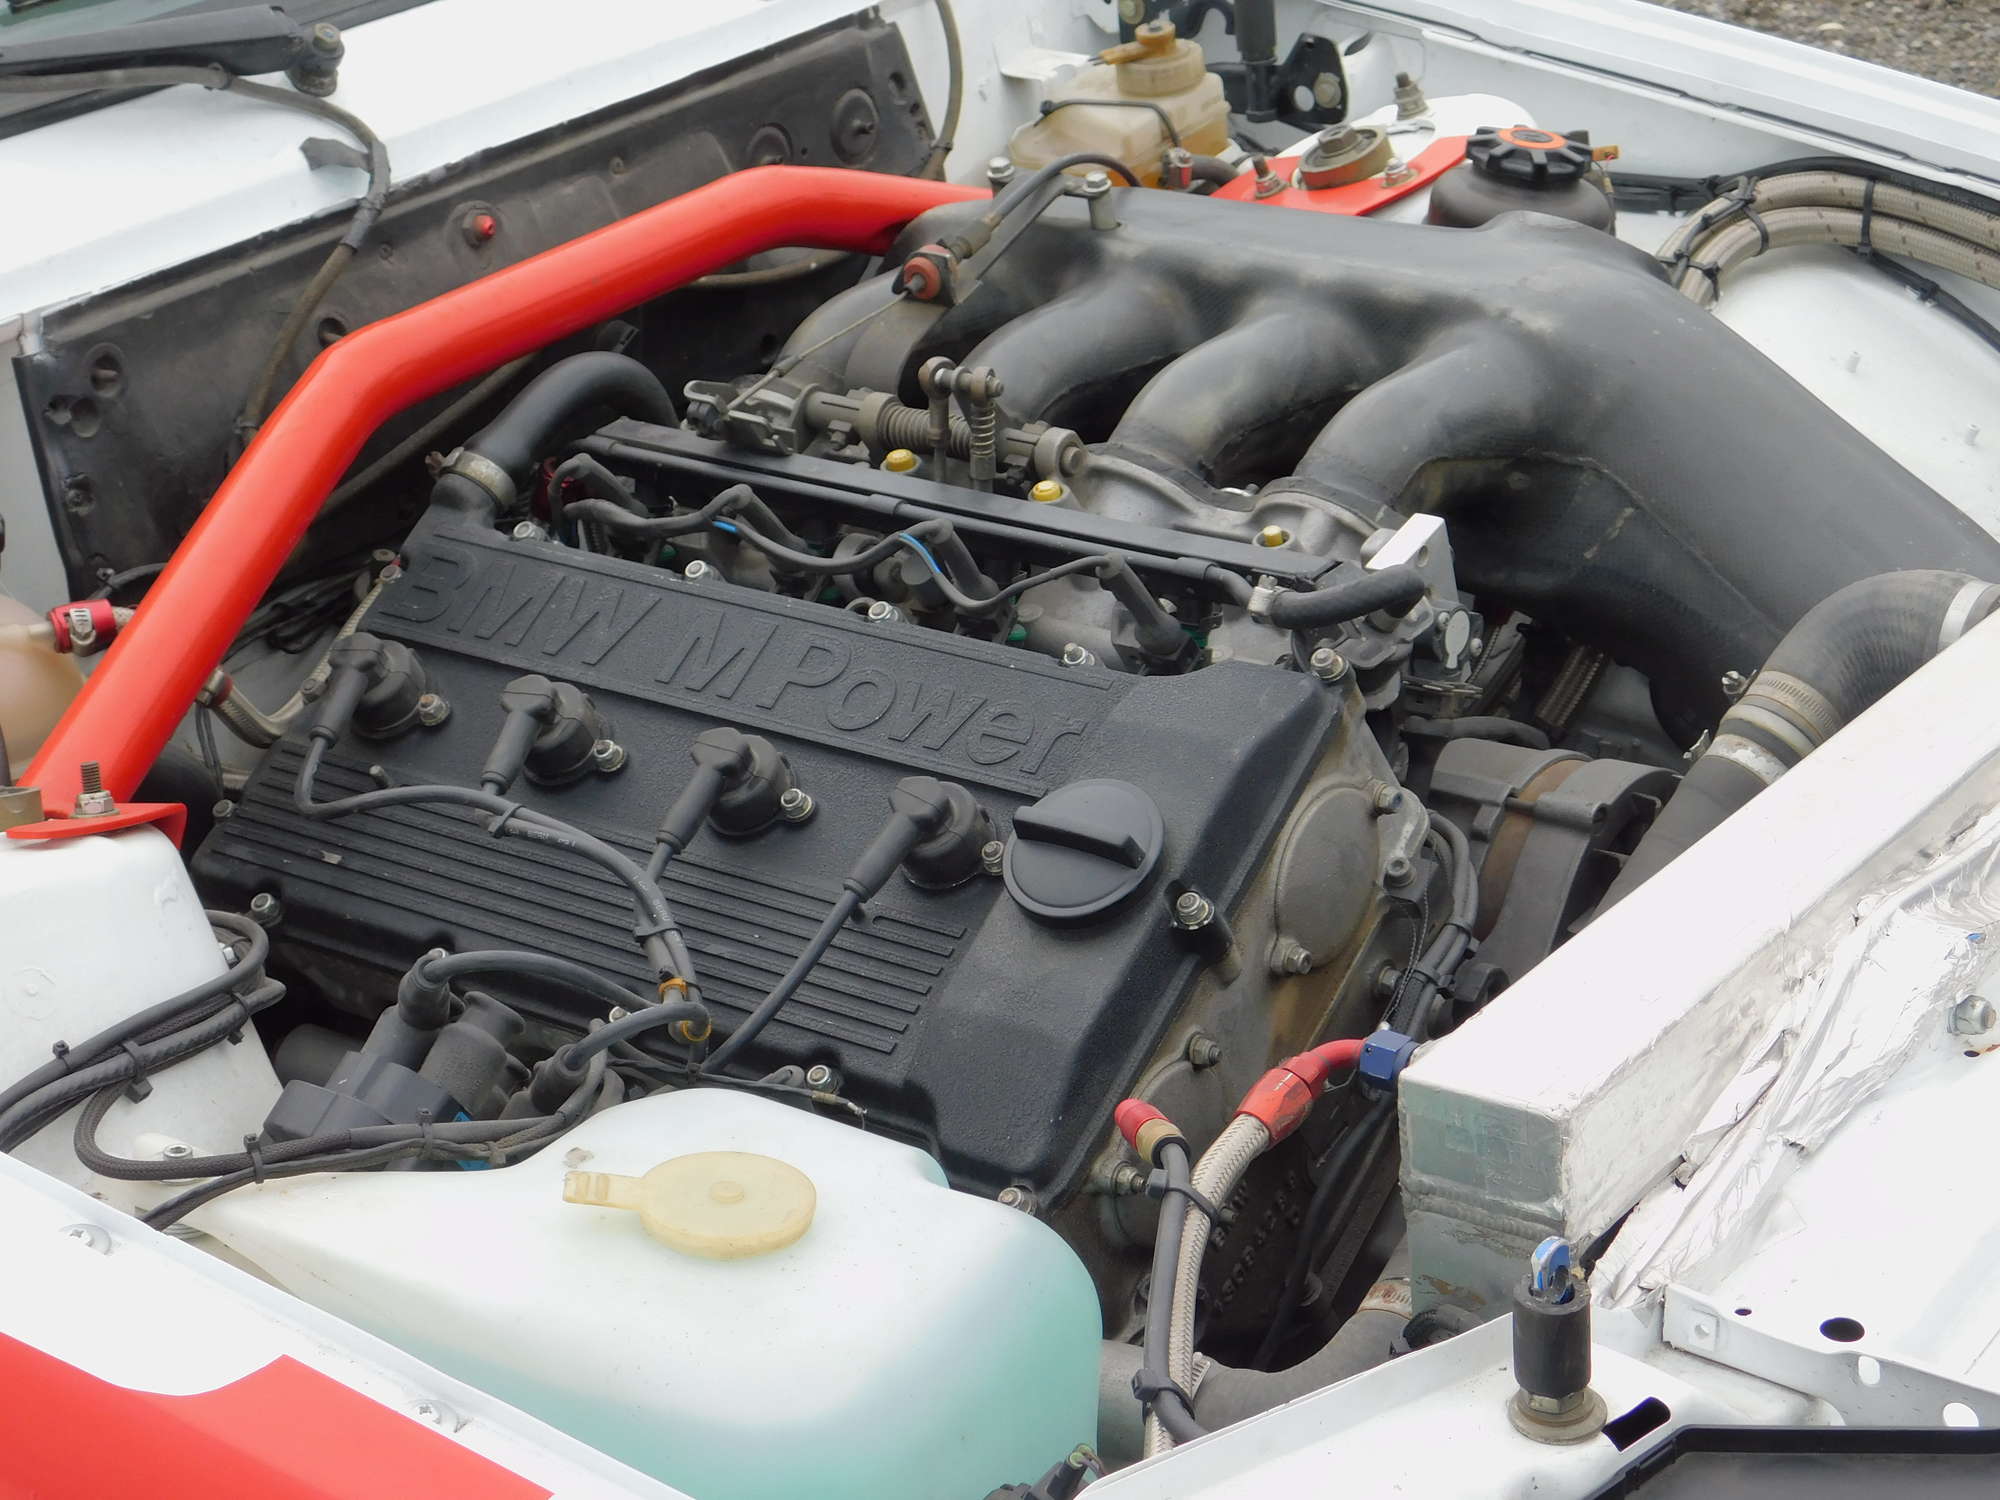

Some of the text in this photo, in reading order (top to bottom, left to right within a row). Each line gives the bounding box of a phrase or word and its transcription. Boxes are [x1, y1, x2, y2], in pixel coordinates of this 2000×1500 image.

[377, 546, 1090, 775] BMW M Power
